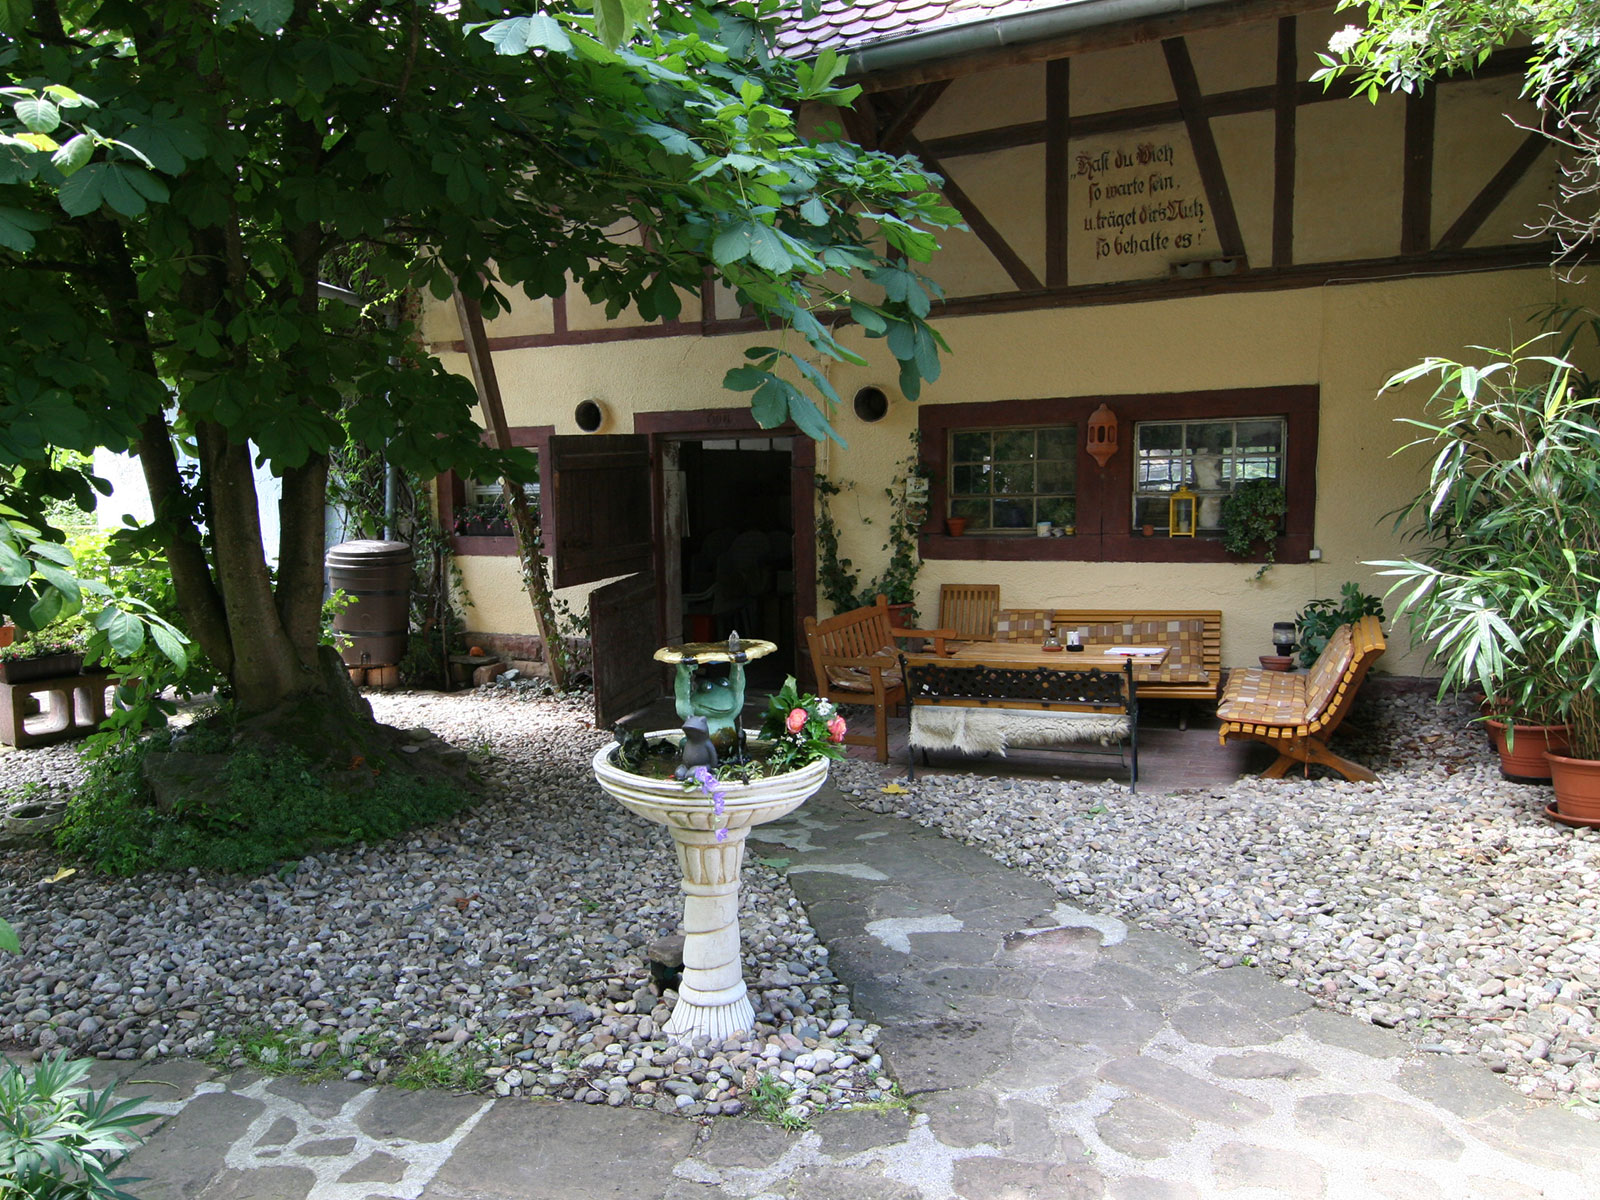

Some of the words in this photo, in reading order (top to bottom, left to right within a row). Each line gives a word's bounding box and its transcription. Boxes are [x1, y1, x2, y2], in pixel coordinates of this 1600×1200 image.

[1115, 150, 1134, 168] du
[1105, 176, 1145, 200] warte
[1114, 232, 1169, 256] behalte
